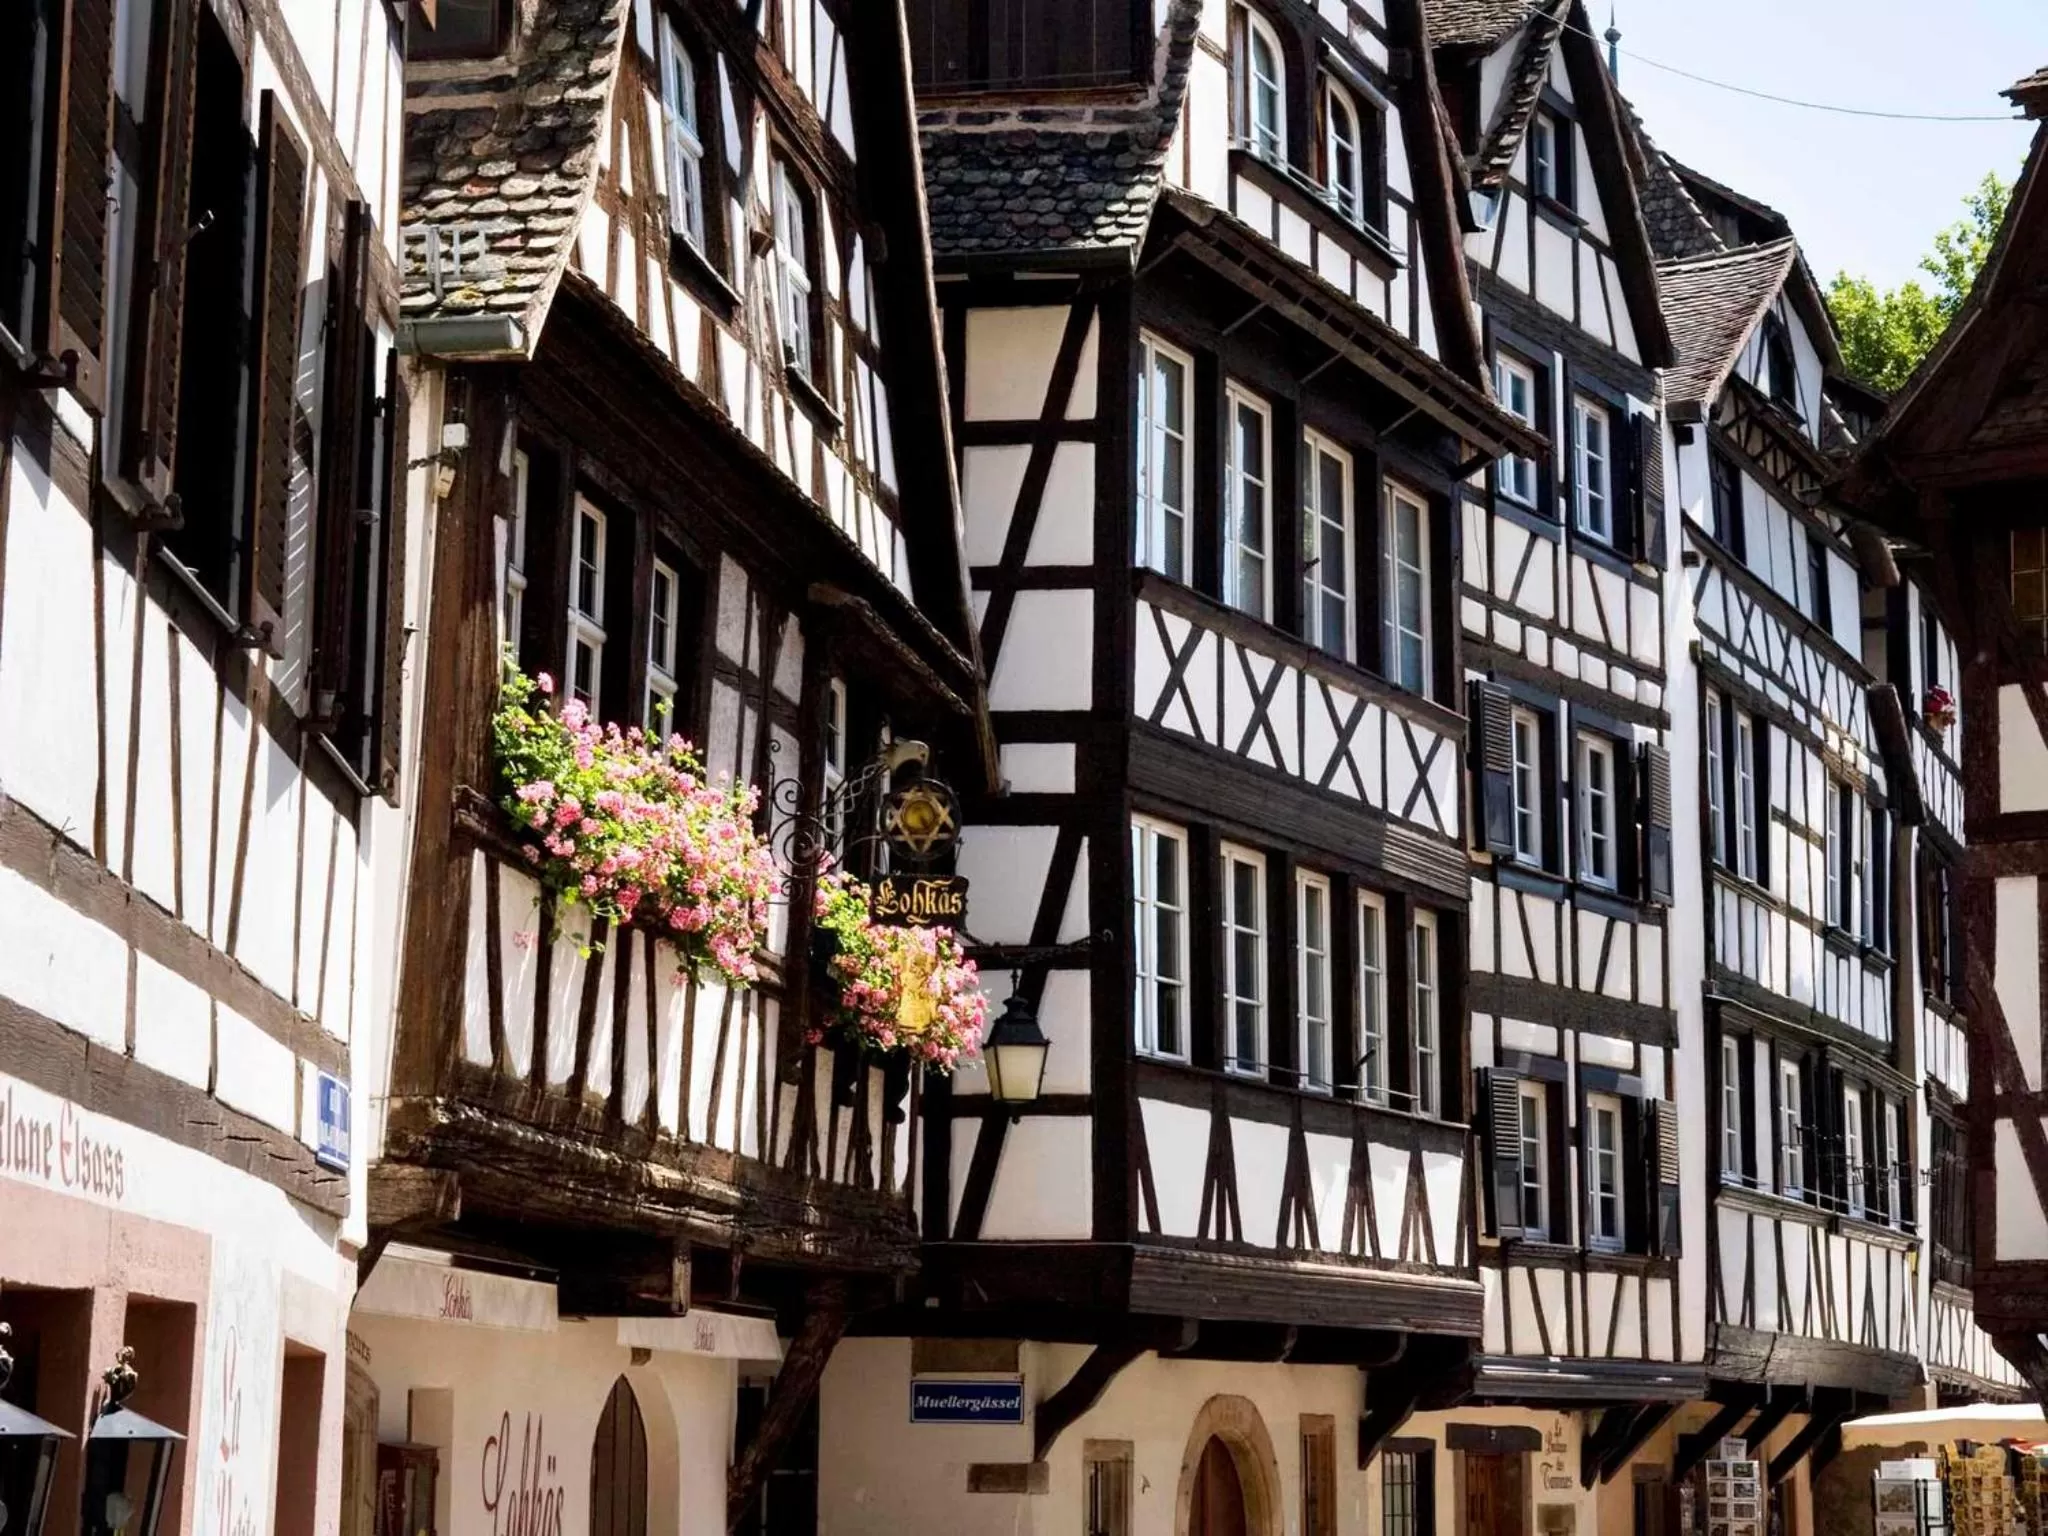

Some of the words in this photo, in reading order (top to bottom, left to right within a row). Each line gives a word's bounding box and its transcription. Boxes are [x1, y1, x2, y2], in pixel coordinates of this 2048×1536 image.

[874, 877, 962, 924] Lohkäs
[59, 1100, 124, 1202] Elsass
[915, 1395, 1020, 1412] Muellergässel
